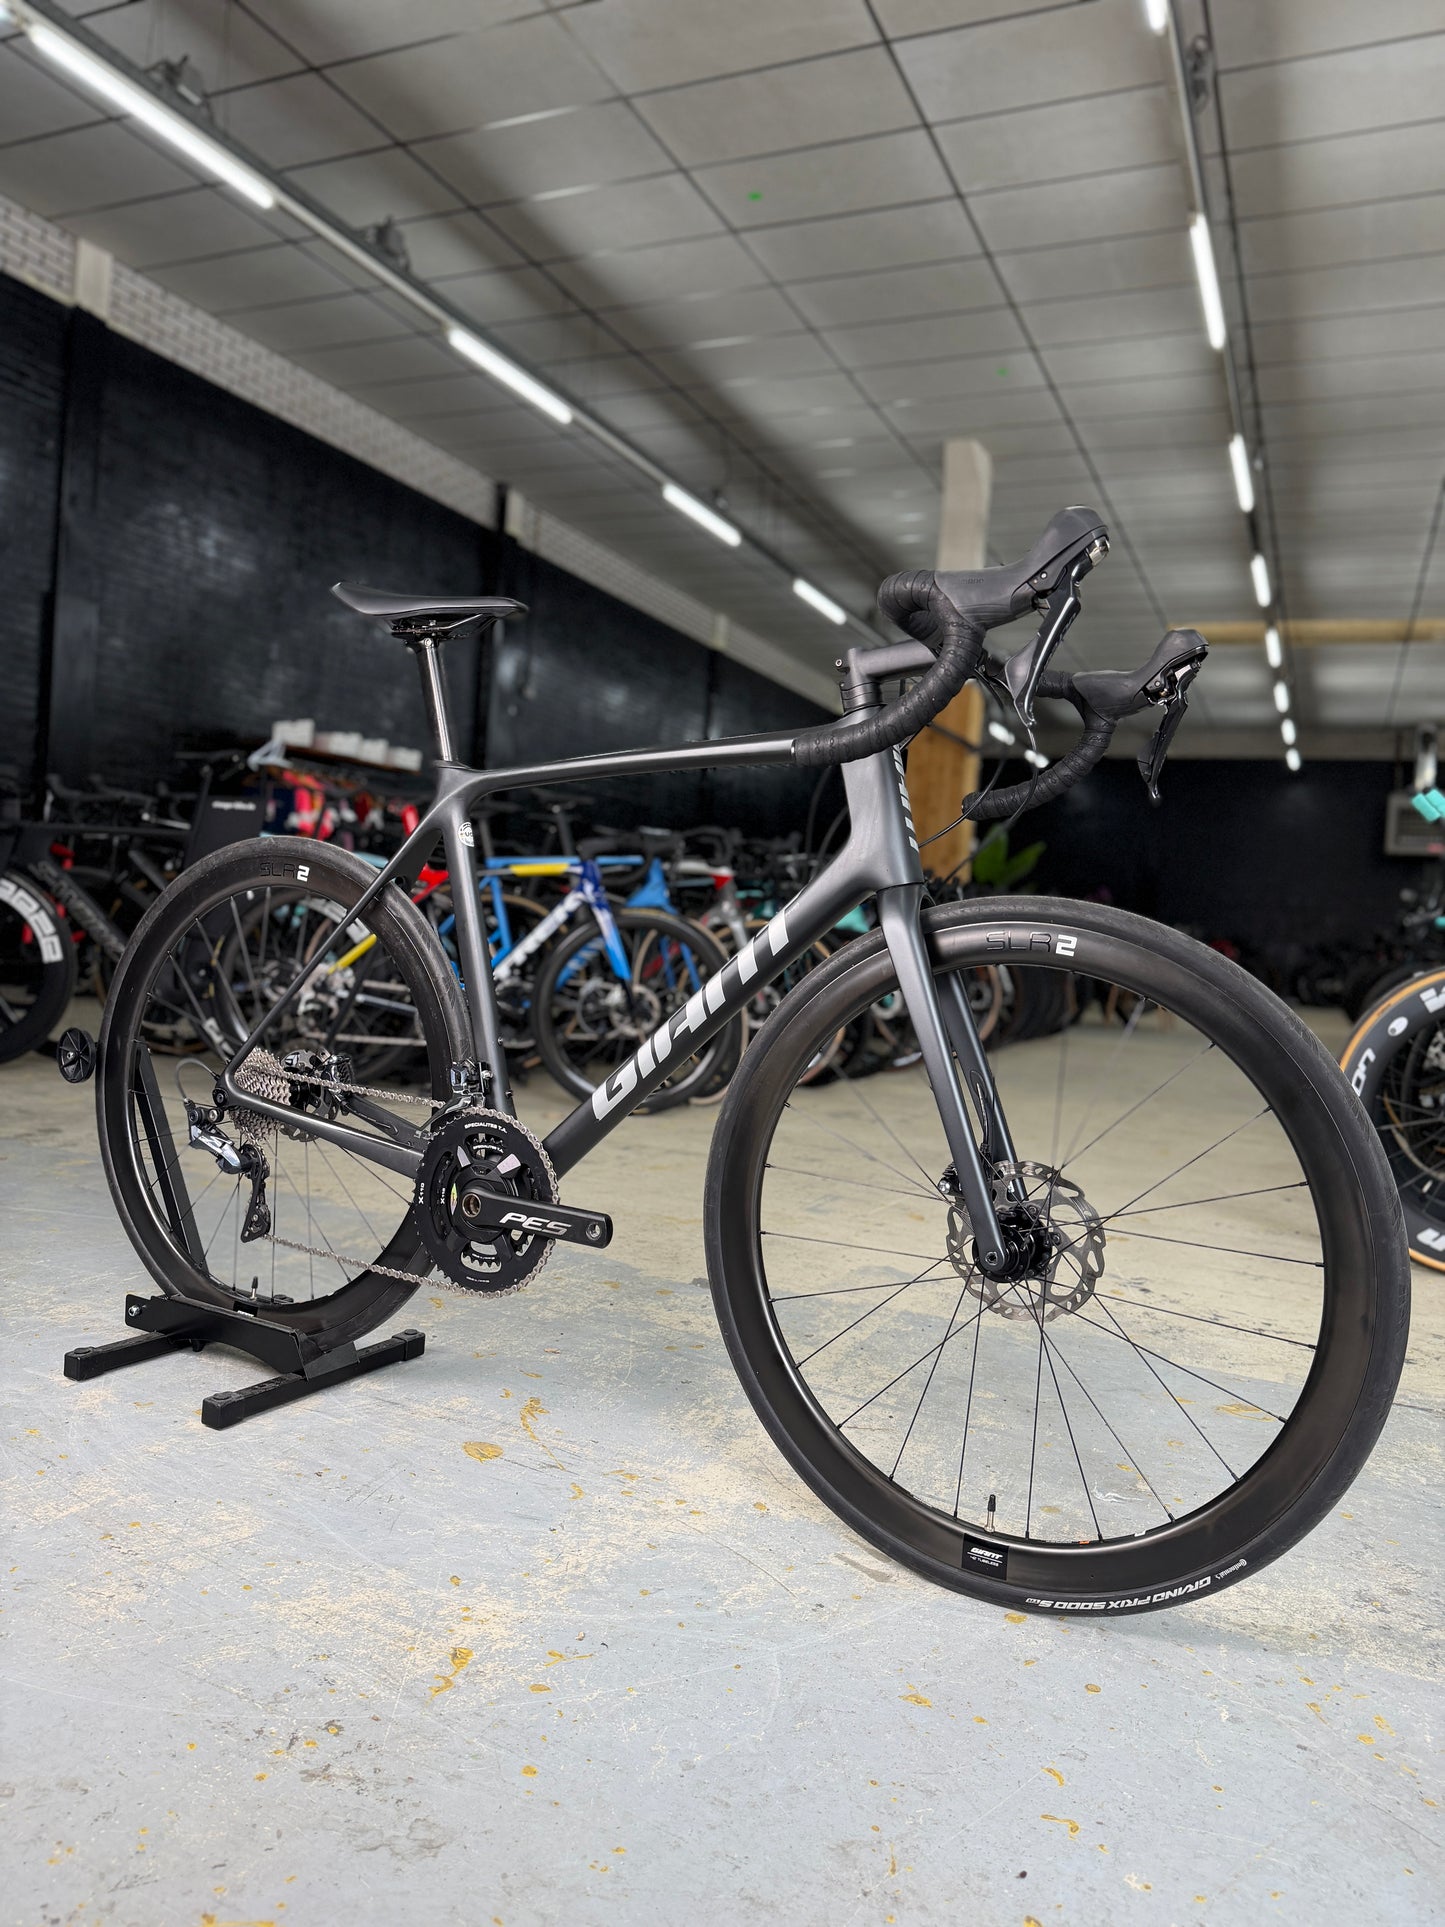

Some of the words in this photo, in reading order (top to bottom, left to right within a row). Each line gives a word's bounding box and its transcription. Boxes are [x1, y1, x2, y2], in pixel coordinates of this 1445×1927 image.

[591, 890, 804, 1121] GIANT
[499, 1212, 572, 1236] PES
[1152, 1576, 1211, 1603] GRAND
[1053, 1601, 1107, 1610] 5000
[1107, 1595, 1151, 1609] PRIX
